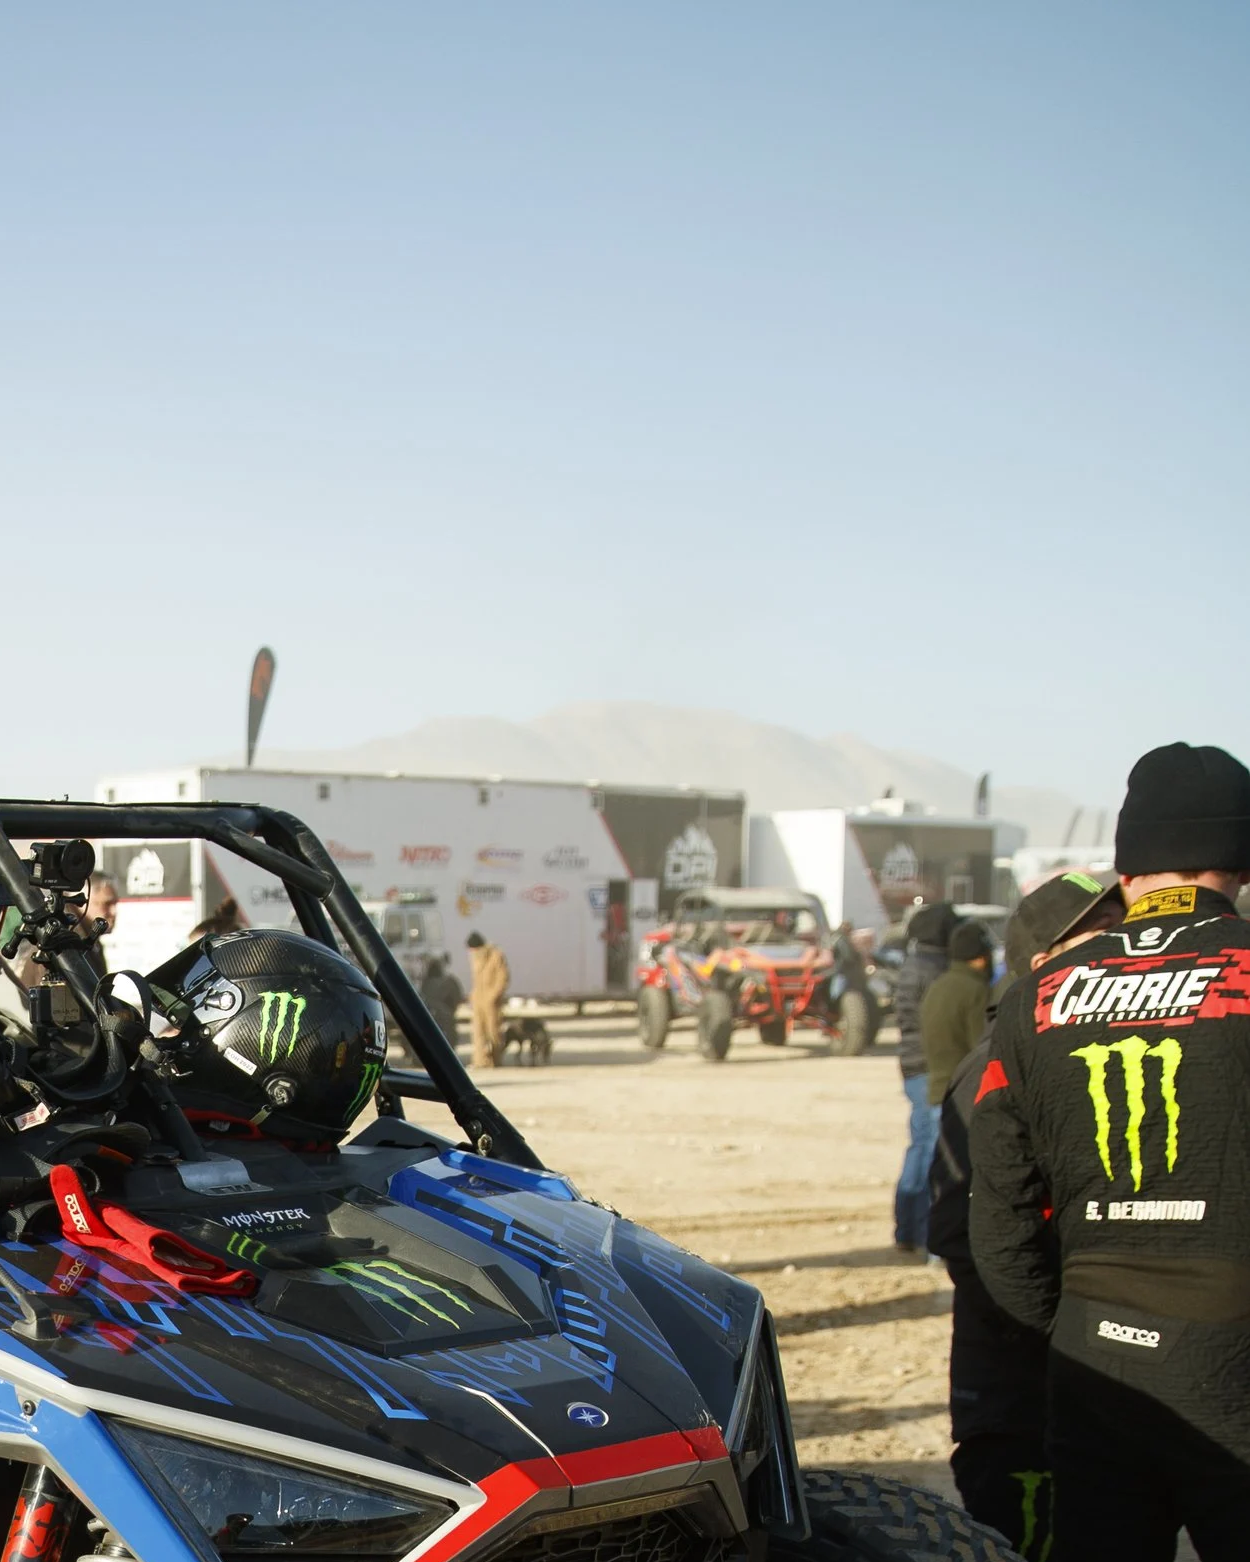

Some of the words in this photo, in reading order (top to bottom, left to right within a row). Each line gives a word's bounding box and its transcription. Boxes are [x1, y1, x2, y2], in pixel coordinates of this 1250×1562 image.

[1050, 965, 1221, 1025] CURRIE
[1075, 1006, 1190, 1025] ENTERPRISES
[222, 1208, 310, 1227] MONSTER
[1085, 1200, 1103, 1220] S.
[1108, 1200, 1206, 1220] BERRIMAN
[245, 1223, 303, 1235] ENERGY
[1097, 1320, 1161, 1348] sparco
